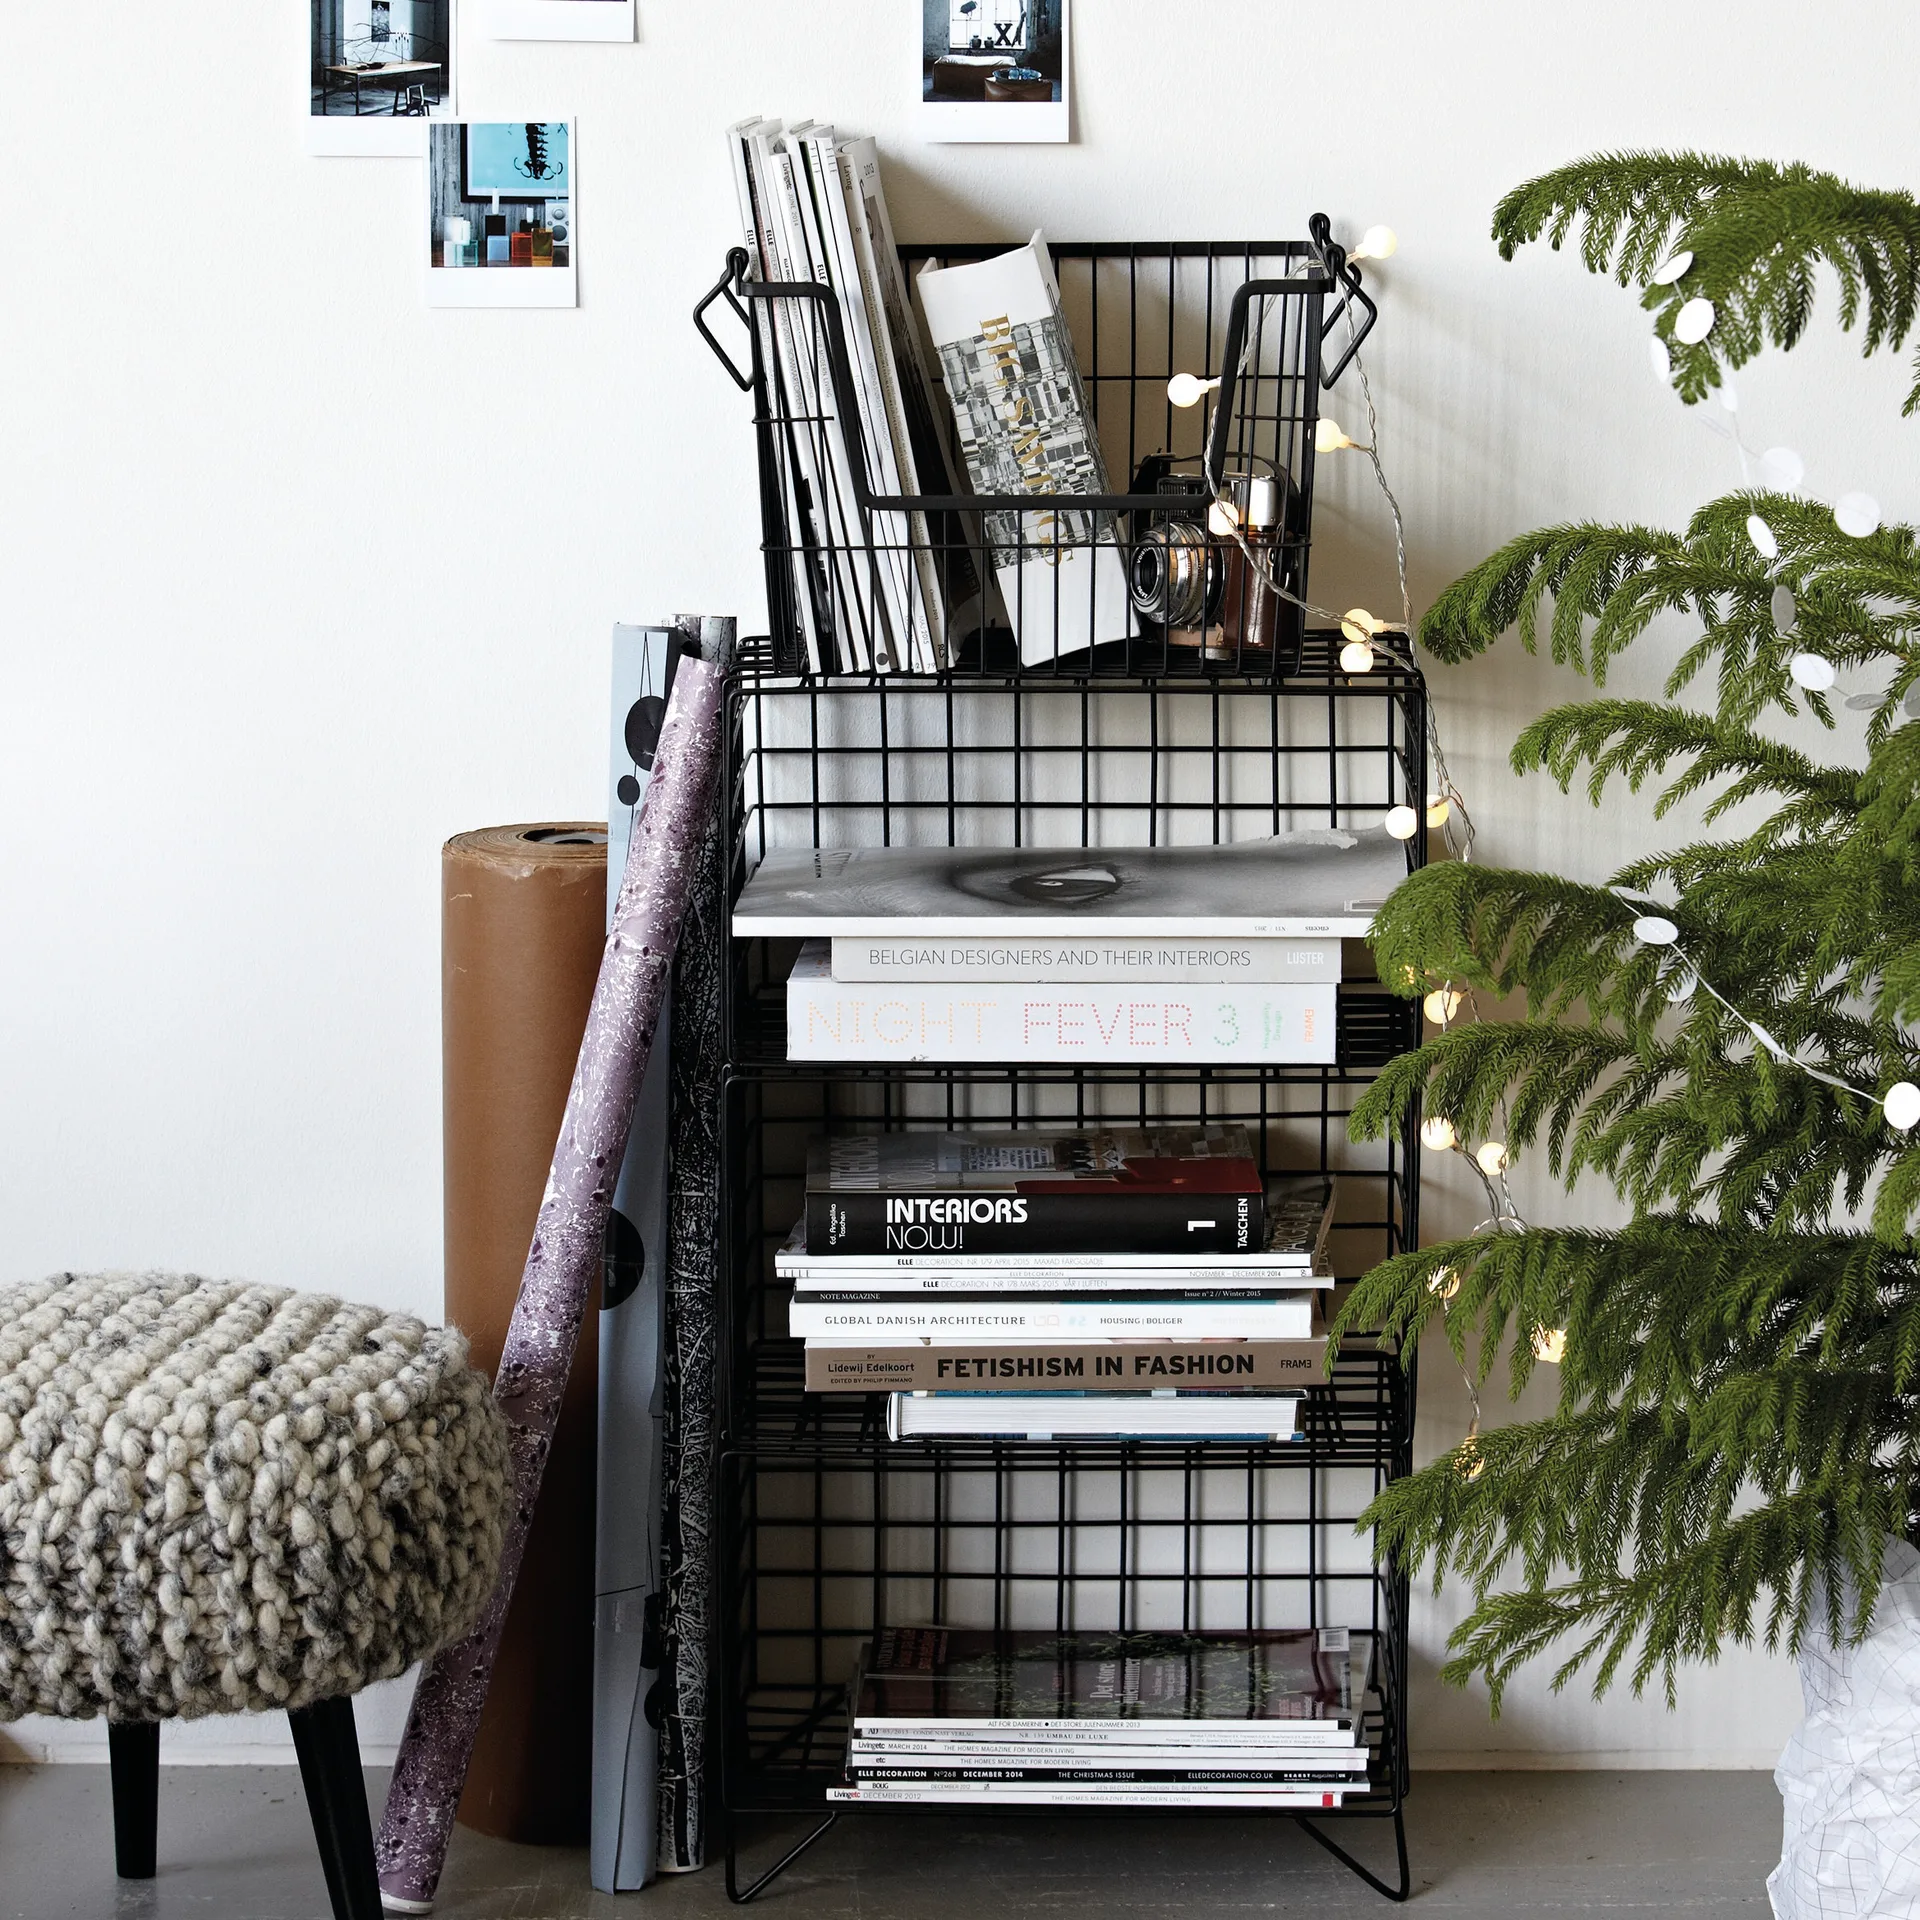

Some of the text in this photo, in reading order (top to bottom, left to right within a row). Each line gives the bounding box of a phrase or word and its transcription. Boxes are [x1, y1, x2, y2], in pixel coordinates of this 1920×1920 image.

[841, 164, 855, 191] Living
[787, 193, 795, 209] JUNE
[745, 229, 755, 246] ELLE
[765, 229, 774, 246] ELLE
[816, 263, 826, 281] ELLE
[979, 312, 1025, 389] BIG
[816, 350, 832, 398] MODERN LIVING
[920, 629, 929, 645] 2015
[869, 949, 1324, 967] BELGIAN DESIGNERS AND THEIR INTERIORS LUSTER
[808, 1001, 1240, 1046] NIGHT FEVER 3
[829, 1136, 880, 1189] INTERIORS
[886, 1198, 1028, 1224] INTERIORS
[829, 1203, 838, 1246] Ed. Angelika
[838, 1211, 846, 1238] Taschen
[1187, 1220, 1216, 1232] 1
[1237, 1198, 1248, 1249] TASCHEN
[886, 1225, 963, 1250] NOW!
[897, 1258, 913, 1266] ELLE
[915, 1258, 963, 1266] DECORATION
[941, 1280, 990, 1288] DECORATION
[1020, 1280, 1041, 1288] MARS
[1042, 1280, 1059, 1288] 2015
[841, 1292, 881, 1300] MAGAZINE
[824, 1316, 873, 1325] GLOBAL
[876, 1316, 926, 1325] DANISH
[930, 1316, 1026, 1325] ARCHITECTURE
[1100, 1317, 1140, 1325] HOUSING
[1146, 1317, 1183, 1325] BOLIGER
[828, 1363, 915, 1374] Lidewij Edelkoort
[937, 1357, 1084, 1378] FETISHISM
[1095, 1356, 1123, 1376] IN
[1134, 1354, 1254, 1376] FASHION
[884, 1376, 913, 1384] FIMMANO
[1090, 1664, 1115, 1698] Det store
[1063, 1721, 1083, 1729] STORE
[1083, 1721, 1124, 1729] JULENUMMER
[858, 1741, 885, 1751] Livingetc
[1054, 1747, 1075, 1755] LIVING
[1058, 1771, 1071, 1779] THE
[1073, 1771, 1114, 1779] CHRISTMAS
[1115, 1771, 1135, 1779] ISSUE
[1187, 1772, 1274, 1780] ELLEDECORATION.CO.UK
[834, 1790, 861, 1799] Livingetc
[863, 1791, 902, 1799] DECEMBER
[904, 1792, 922, 1800] 2012
